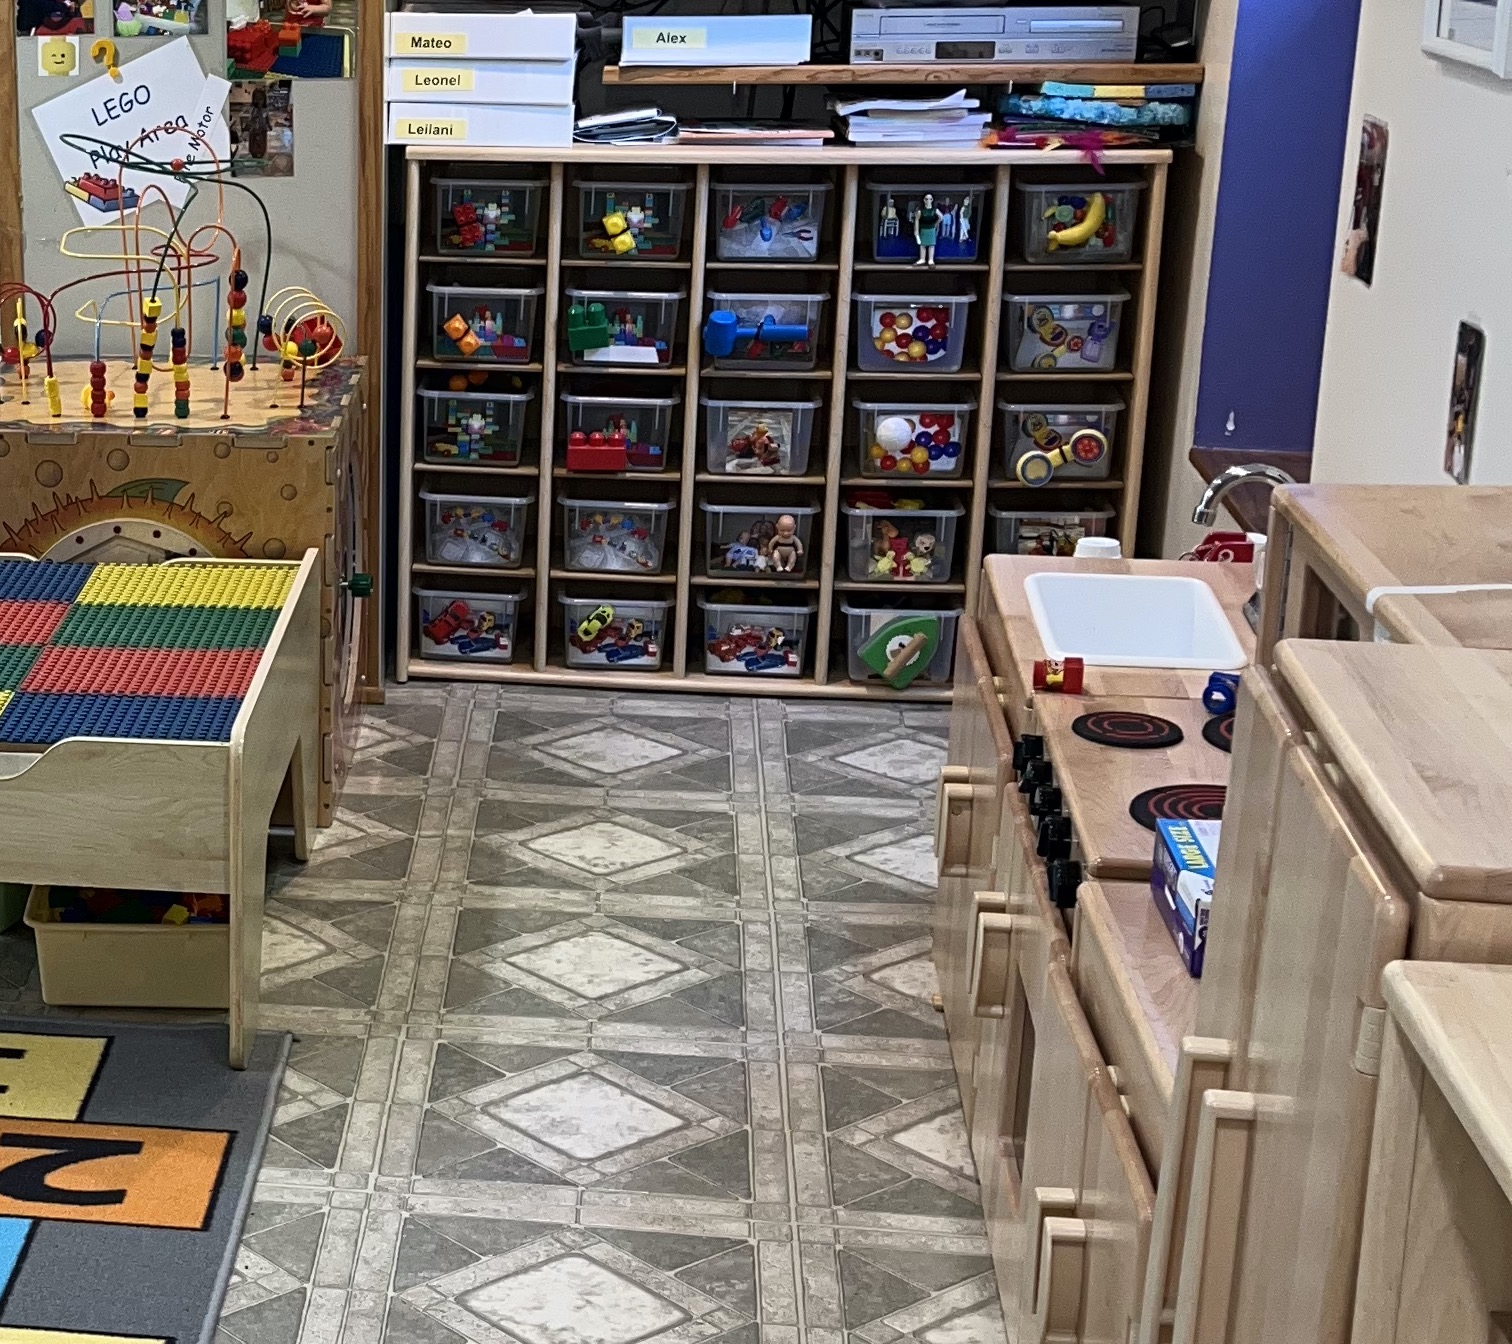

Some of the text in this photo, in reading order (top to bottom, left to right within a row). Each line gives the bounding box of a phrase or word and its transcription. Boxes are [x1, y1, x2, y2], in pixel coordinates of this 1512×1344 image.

[410, 36, 452, 49] Mateo
[656, 32, 687, 44] Alex
[414, 74, 461, 86] Leonel
[91, 84, 151, 127] LEGO
[140, 115, 189, 148] Area
[189, 106, 215, 152] Motor
[408, 123, 454, 136] Leilani
